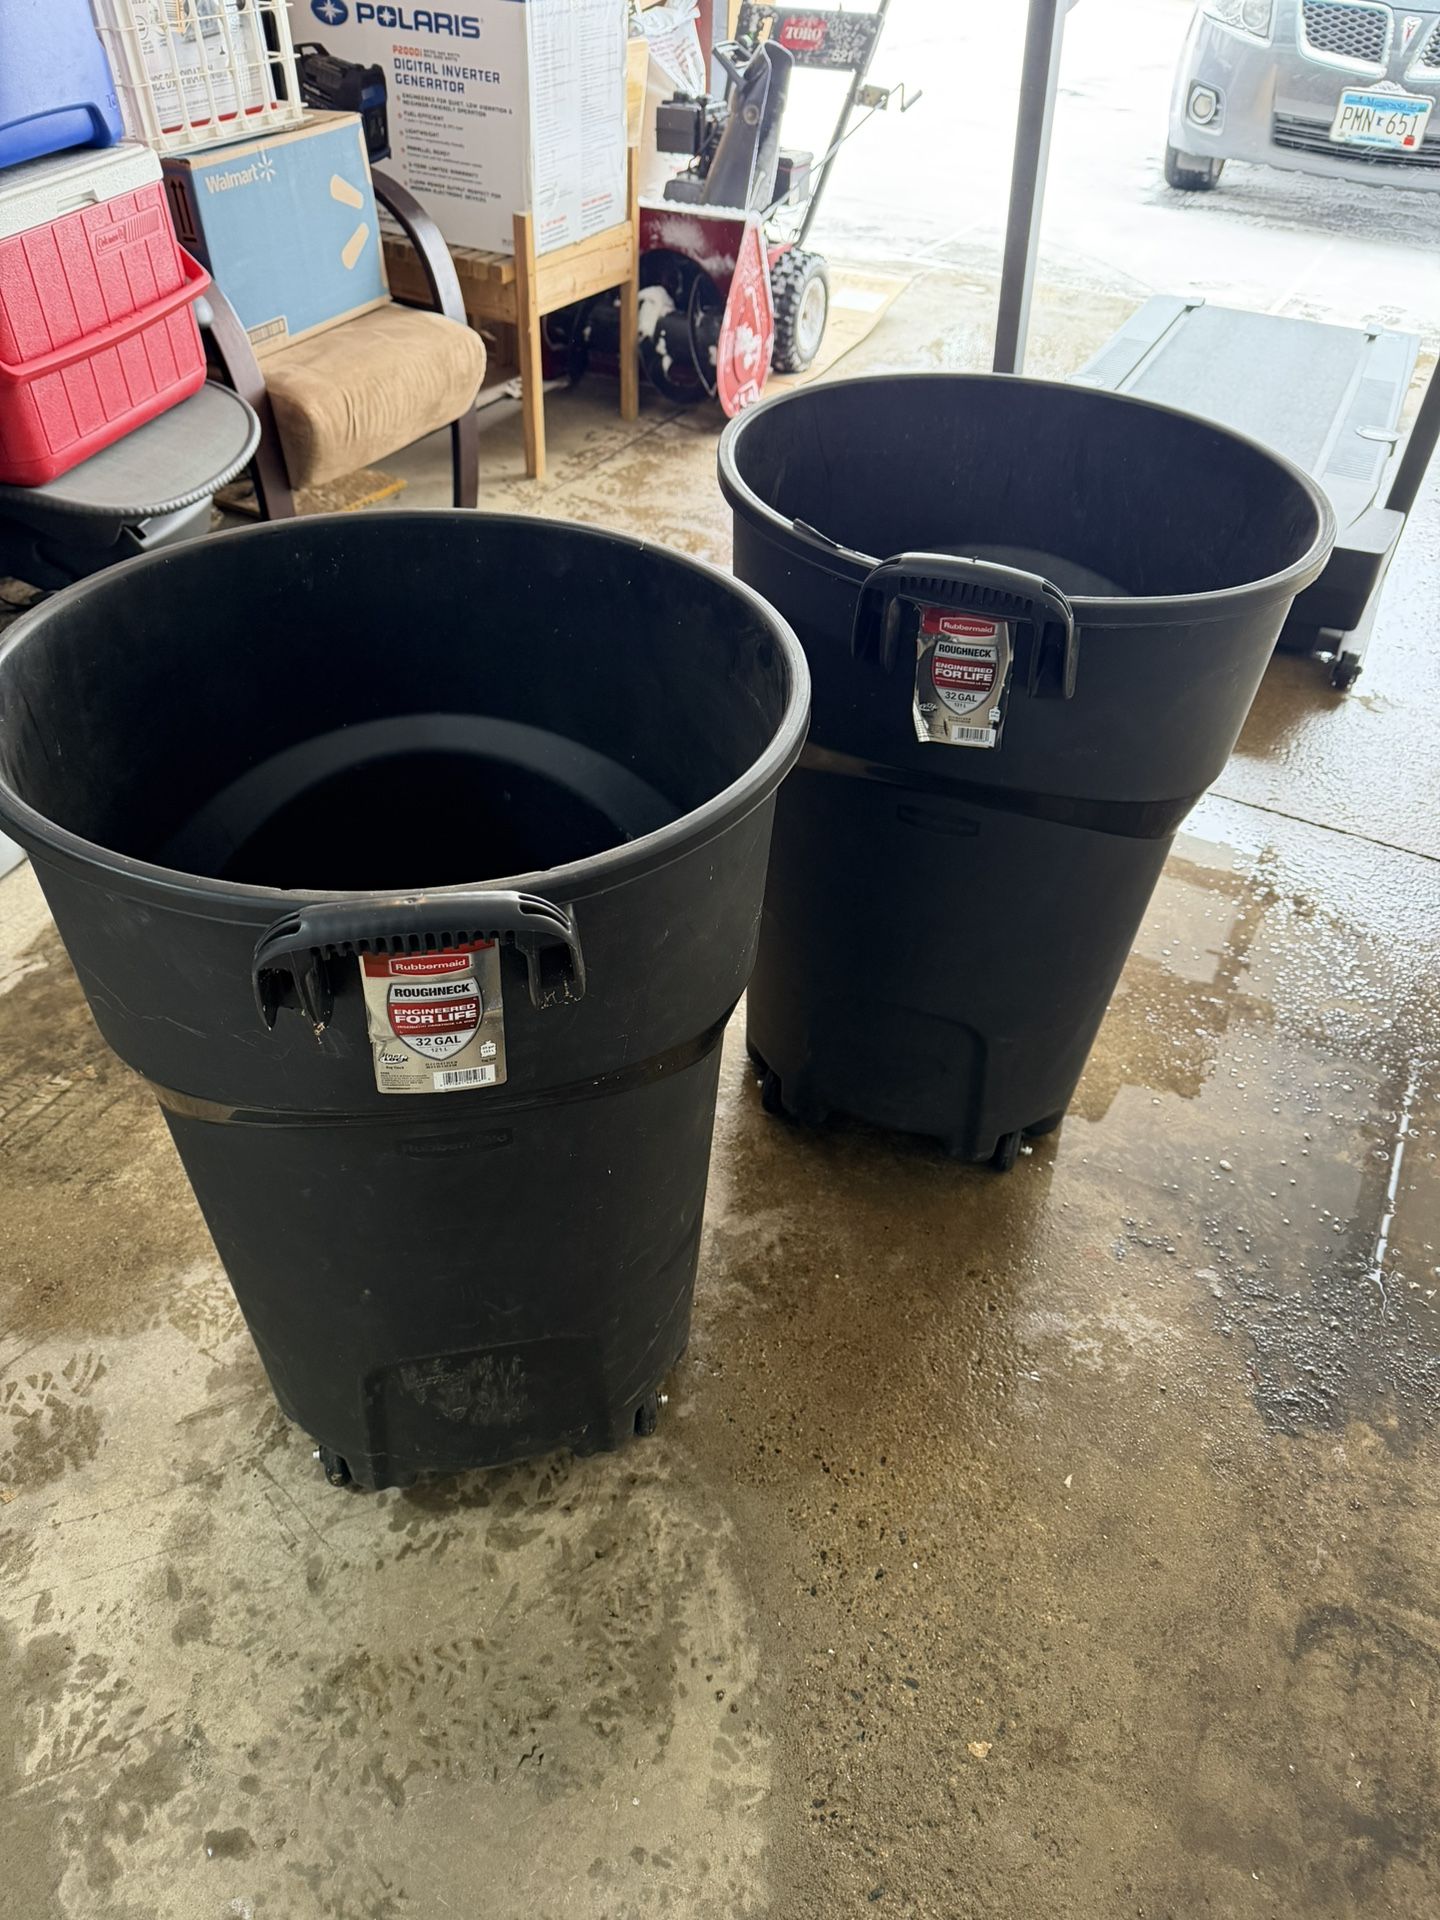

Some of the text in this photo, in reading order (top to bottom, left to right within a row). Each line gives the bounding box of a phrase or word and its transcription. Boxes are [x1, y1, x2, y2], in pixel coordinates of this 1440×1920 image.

[356, 2, 480, 39] POLARIS
[785, 26, 822, 41] TORO
[393, 58, 501, 84] DIGITAL INVERTER
[395, 73, 465, 94] GENERATOR
[1339, 106, 1419, 137] PMN 651
[205, 163, 260, 194] Walmart
[943, 621, 993, 633] Rubbermaid
[938, 644, 992, 658] ROUGHNECK
[935, 662, 993, 673] ENGINEERED
[935, 668, 962, 679] FOR
[963, 672, 993, 682] LIFE
[945, 691, 977, 703] 32 GAL
[395, 959, 466, 971] Rubbermaid
[394, 983, 471, 997] ROUGHNECK
[394, 1003, 476, 1015] ENGINEERED
[395, 1014, 434, 1024] FOR
[437, 1009, 477, 1023] LIFE
[416, 1035, 461, 1047] 32 GAL
